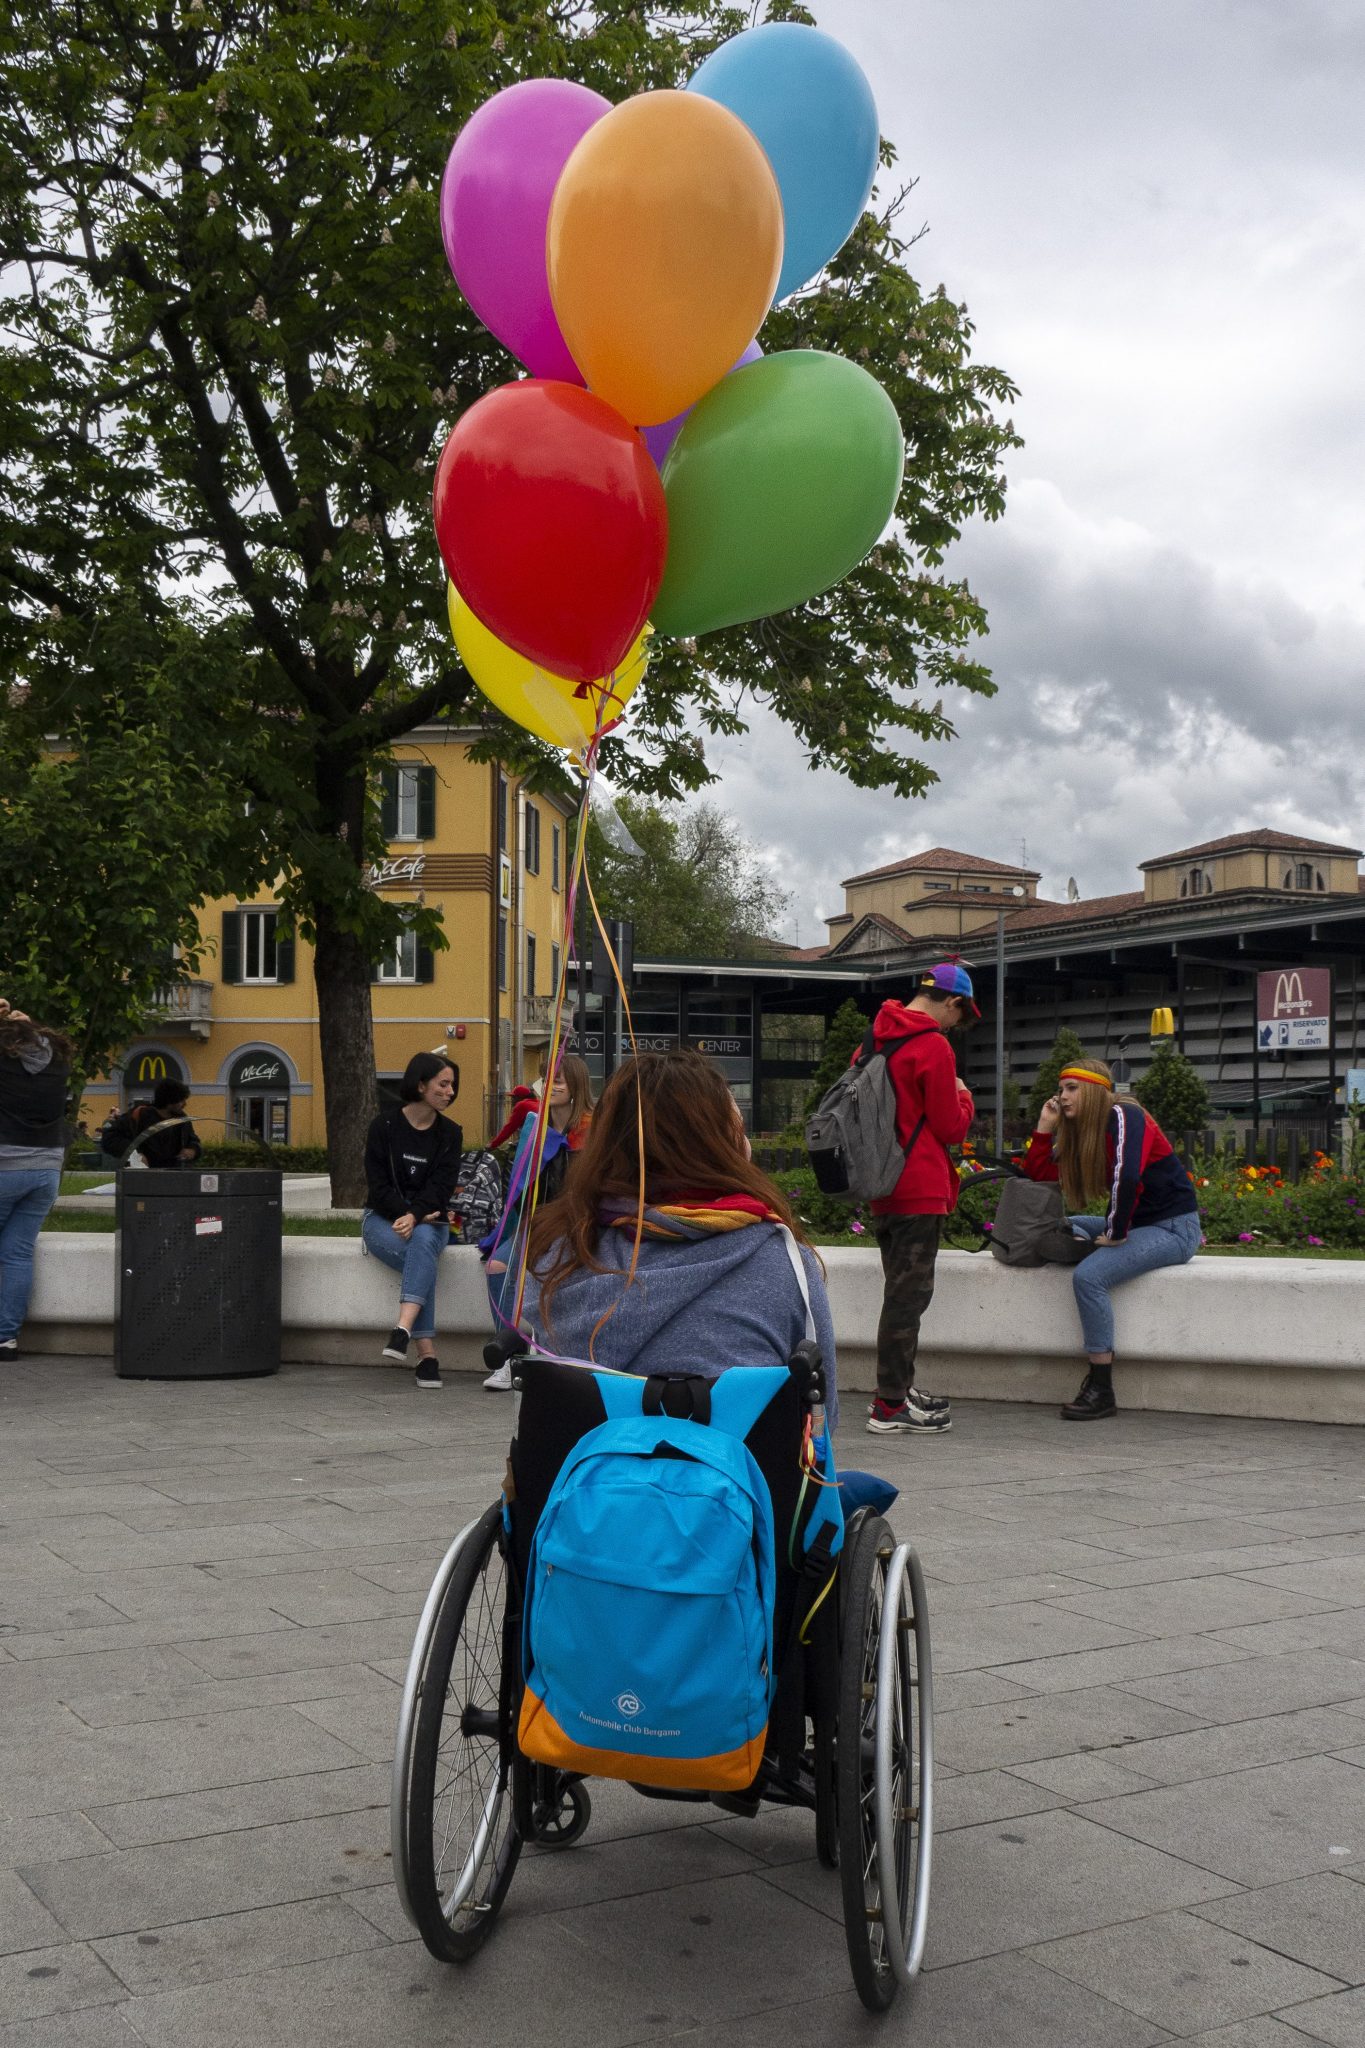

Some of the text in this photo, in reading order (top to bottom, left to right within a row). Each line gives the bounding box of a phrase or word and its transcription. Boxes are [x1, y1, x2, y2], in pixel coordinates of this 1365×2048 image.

[1293, 1019, 1326, 1028] RISERVATO
[621, 1038, 670, 1051] SCIENCE
[698, 1039, 741, 1052] CENTER
[1297, 1037, 1321, 1045] CLIENTI
[579, 1710, 681, 1738] Automobile Club Bergamo
